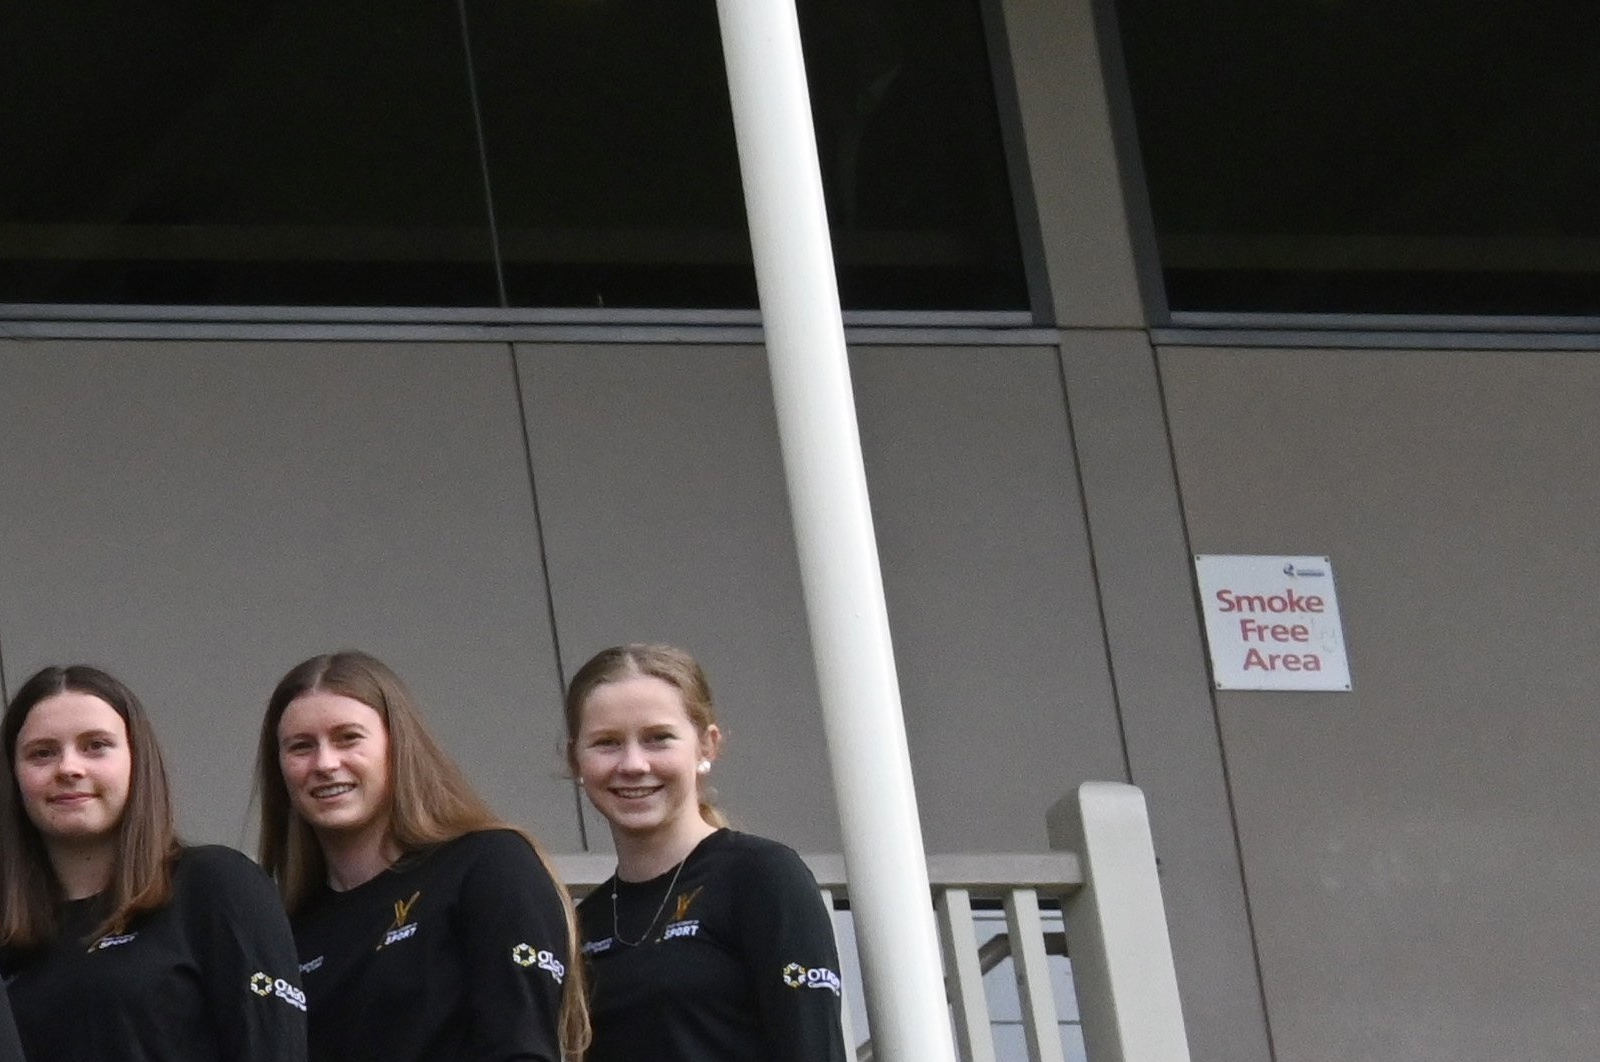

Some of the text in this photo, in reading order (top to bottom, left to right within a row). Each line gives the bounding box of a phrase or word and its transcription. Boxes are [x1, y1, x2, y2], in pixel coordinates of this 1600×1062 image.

[1216, 588, 1325, 614] Smoke
[1239, 618, 1310, 642] Free
[1242, 648, 1321, 671] Area
[662, 925, 699, 940] SPORT
